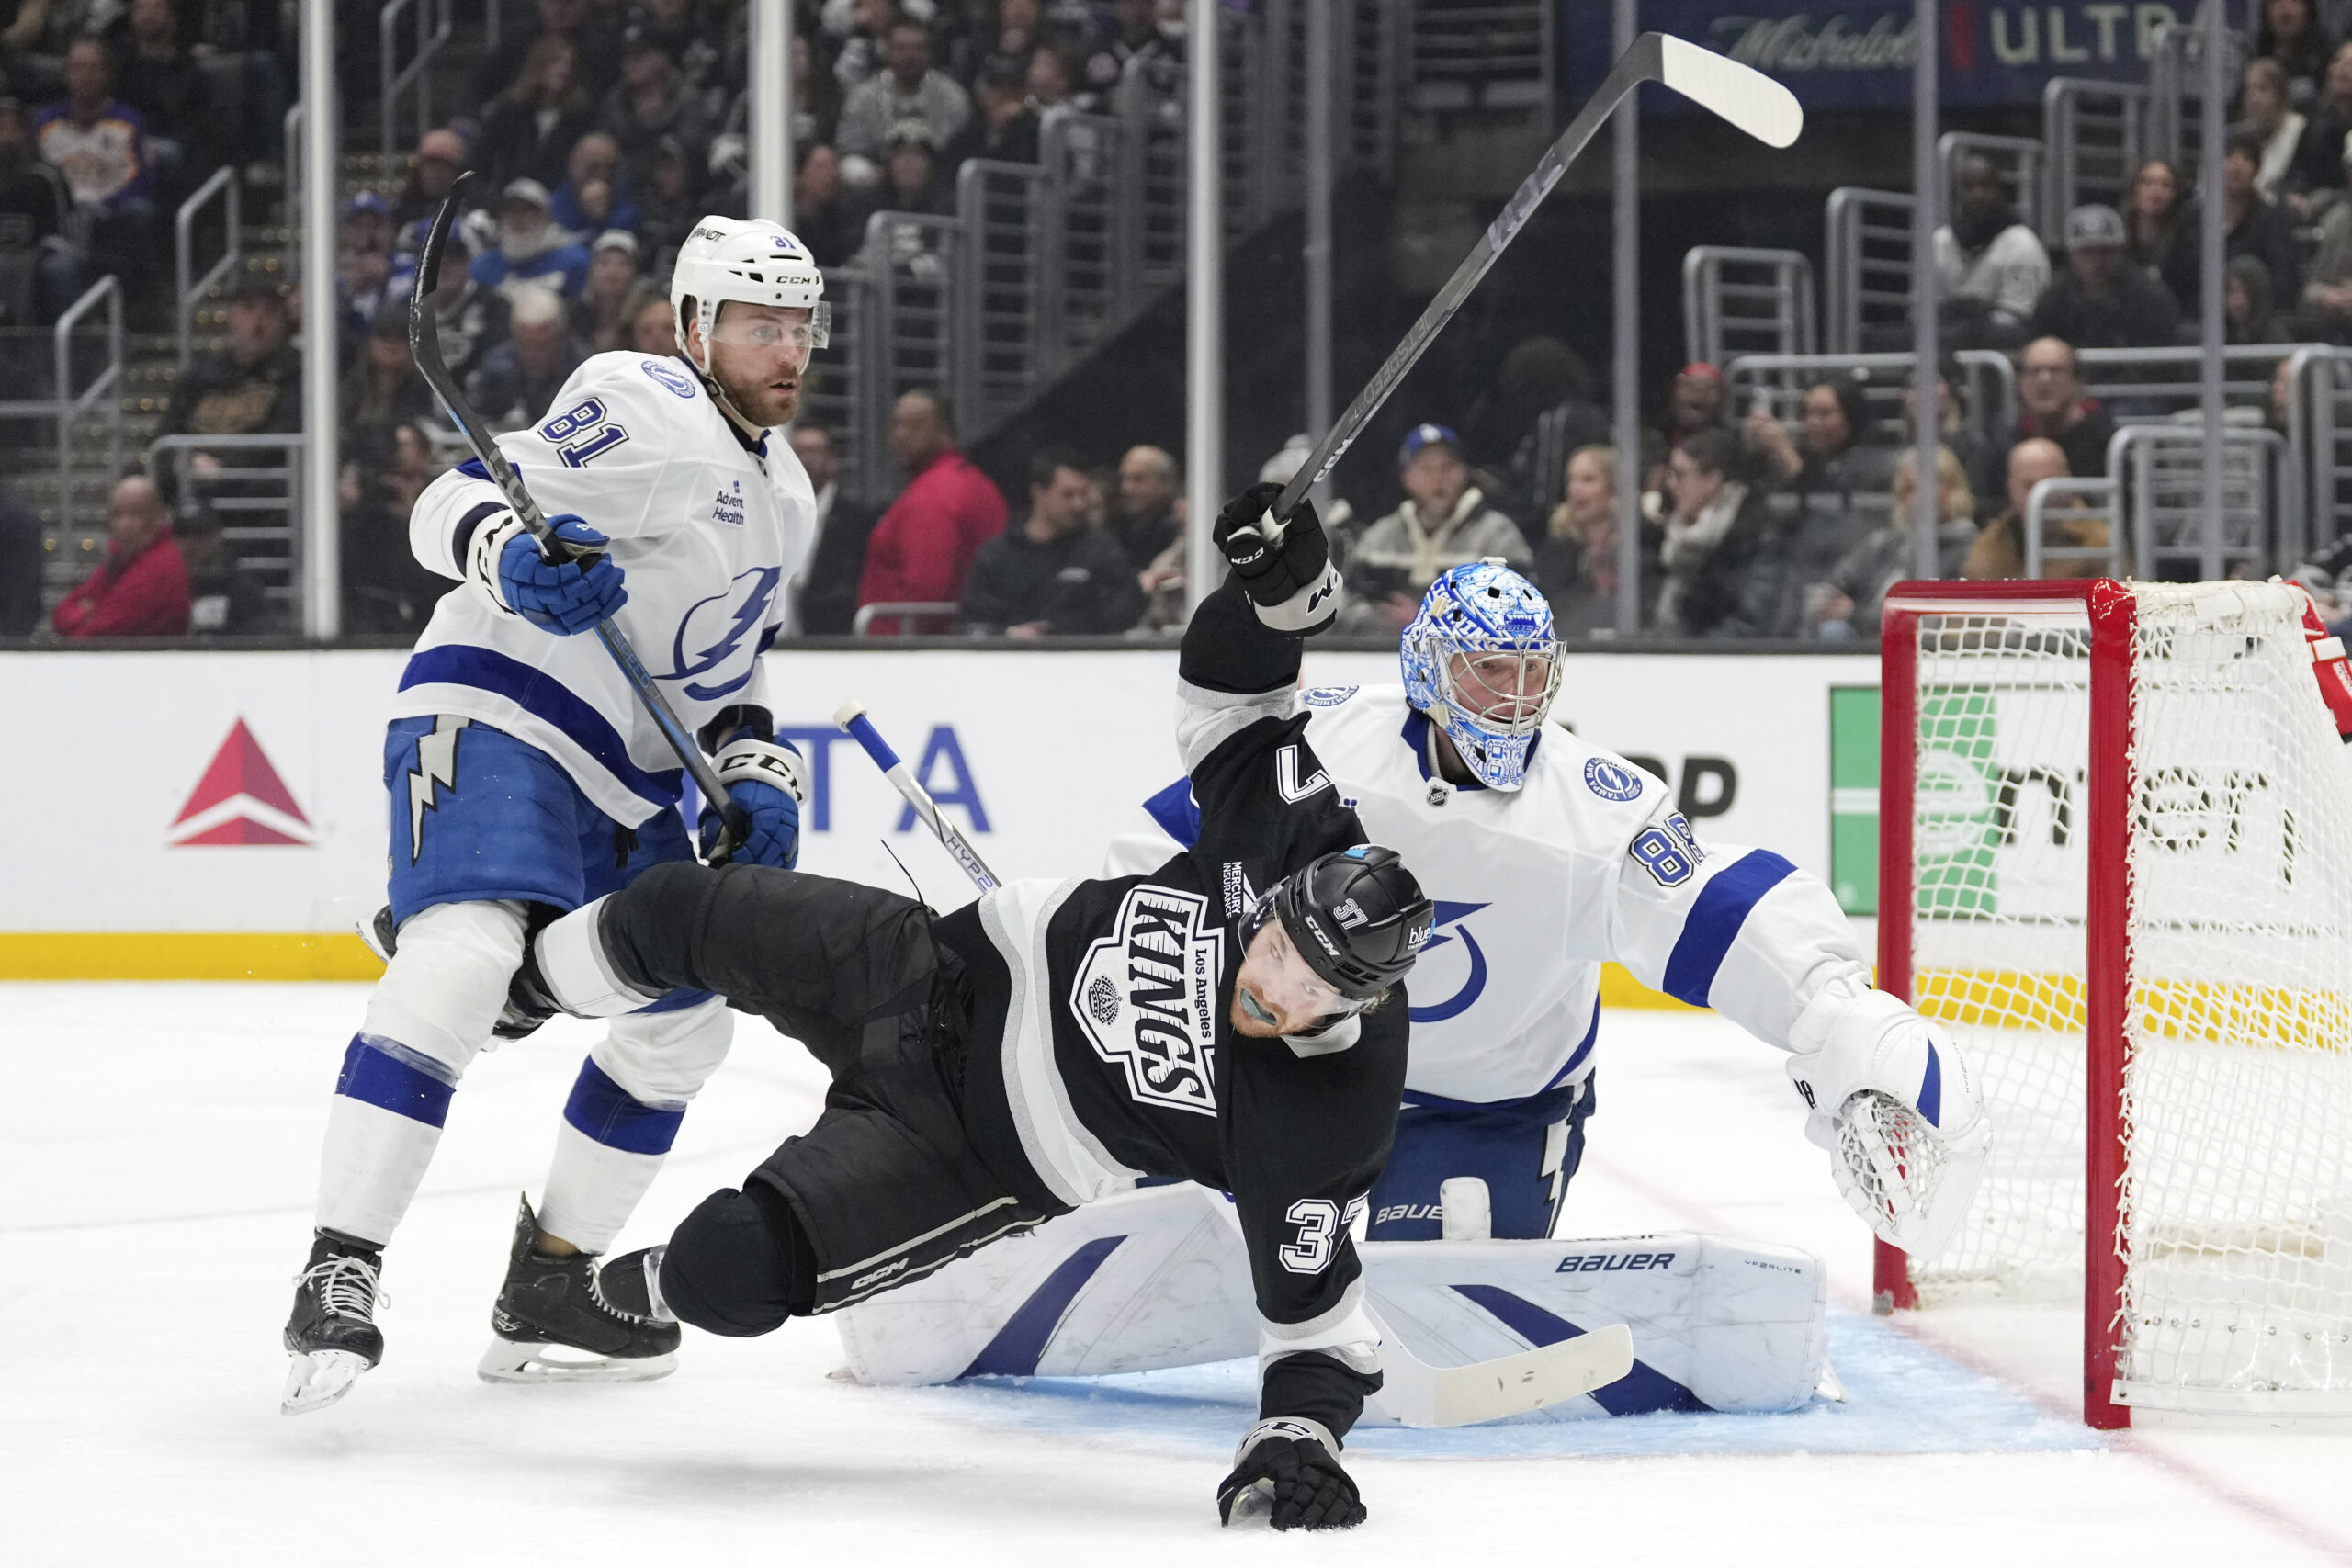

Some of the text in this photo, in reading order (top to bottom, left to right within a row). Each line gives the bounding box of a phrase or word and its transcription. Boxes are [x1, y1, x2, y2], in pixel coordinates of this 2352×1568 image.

[776, 276, 810, 284] CCM
[1363, 306, 1433, 404] JETSPEED
[538, 396, 629, 468] 81
[716, 490, 744, 509] Advent
[712, 506, 744, 525] Health
[1230, 547, 1265, 565] CCM
[1496, 624, 1541, 633] BAUER
[1586, 761, 1595, 779] BAY
[1429, 790, 1446, 805] NHL
[1589, 778, 1621, 800] TAMPA
[1222, 862, 1232, 920] INSURANCE
[1231, 861, 1242, 915] MERCURY
[1333, 897, 1369, 931] 37
[1305, 916, 1341, 957] CCM
[1408, 926, 1431, 945] blue
[1128, 898, 1207, 1100] KINGS
[1194, 948, 1212, 1039] Los Angeles
[1374, 1204, 1443, 1226] BAUE
[850, 1257, 910, 1291] CCM
[1555, 1252, 1676, 1274] BAUER
